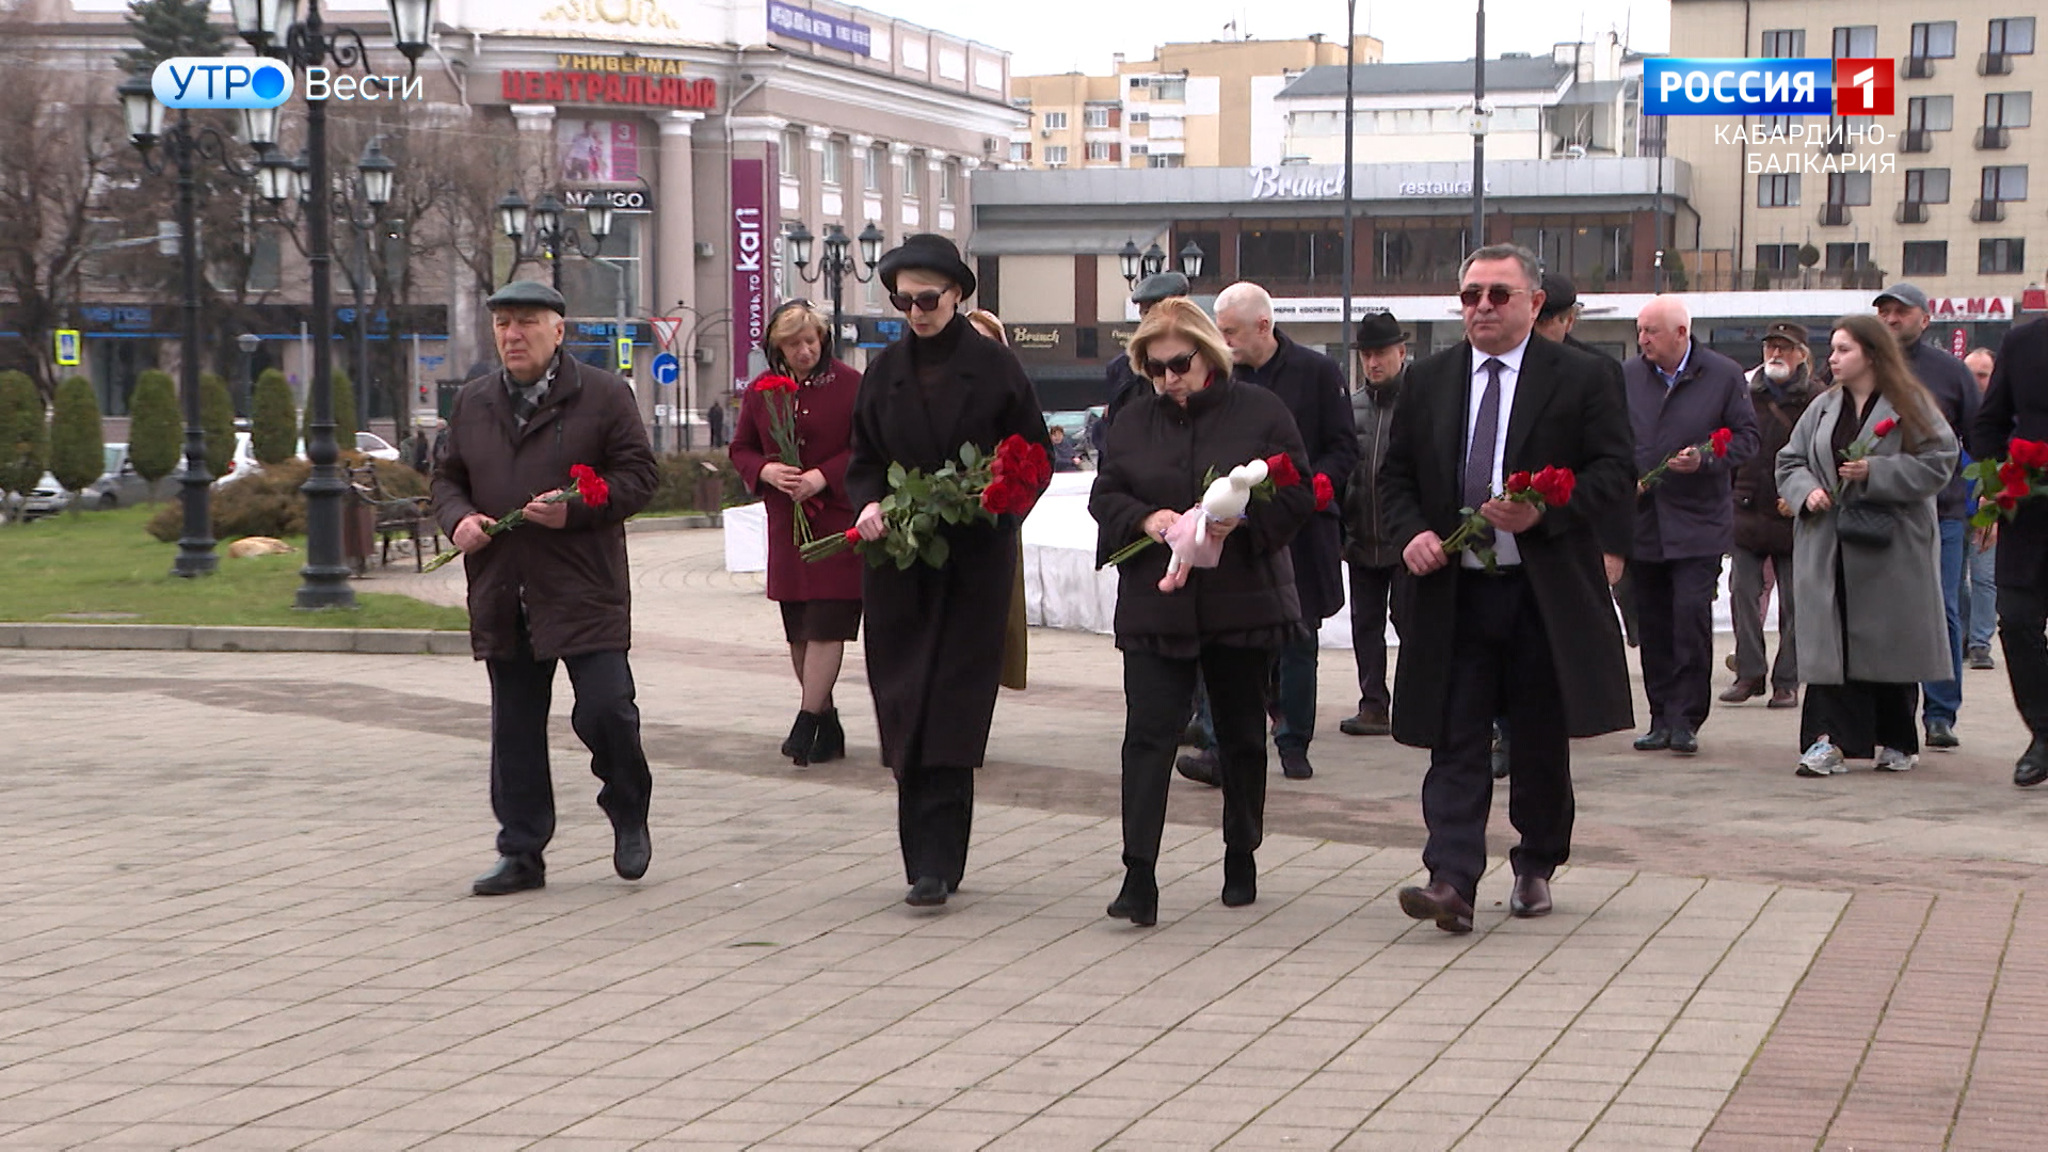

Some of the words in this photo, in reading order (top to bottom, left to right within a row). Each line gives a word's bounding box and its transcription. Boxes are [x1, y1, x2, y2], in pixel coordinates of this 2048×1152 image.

[557, 54, 688, 74] УНИВЕРМАГ
[501, 69, 716, 108] ЦЕНТРАЛЬНЫЙ
[1399, 179, 1490, 195] restaurat
[735, 207, 760, 271] kari
